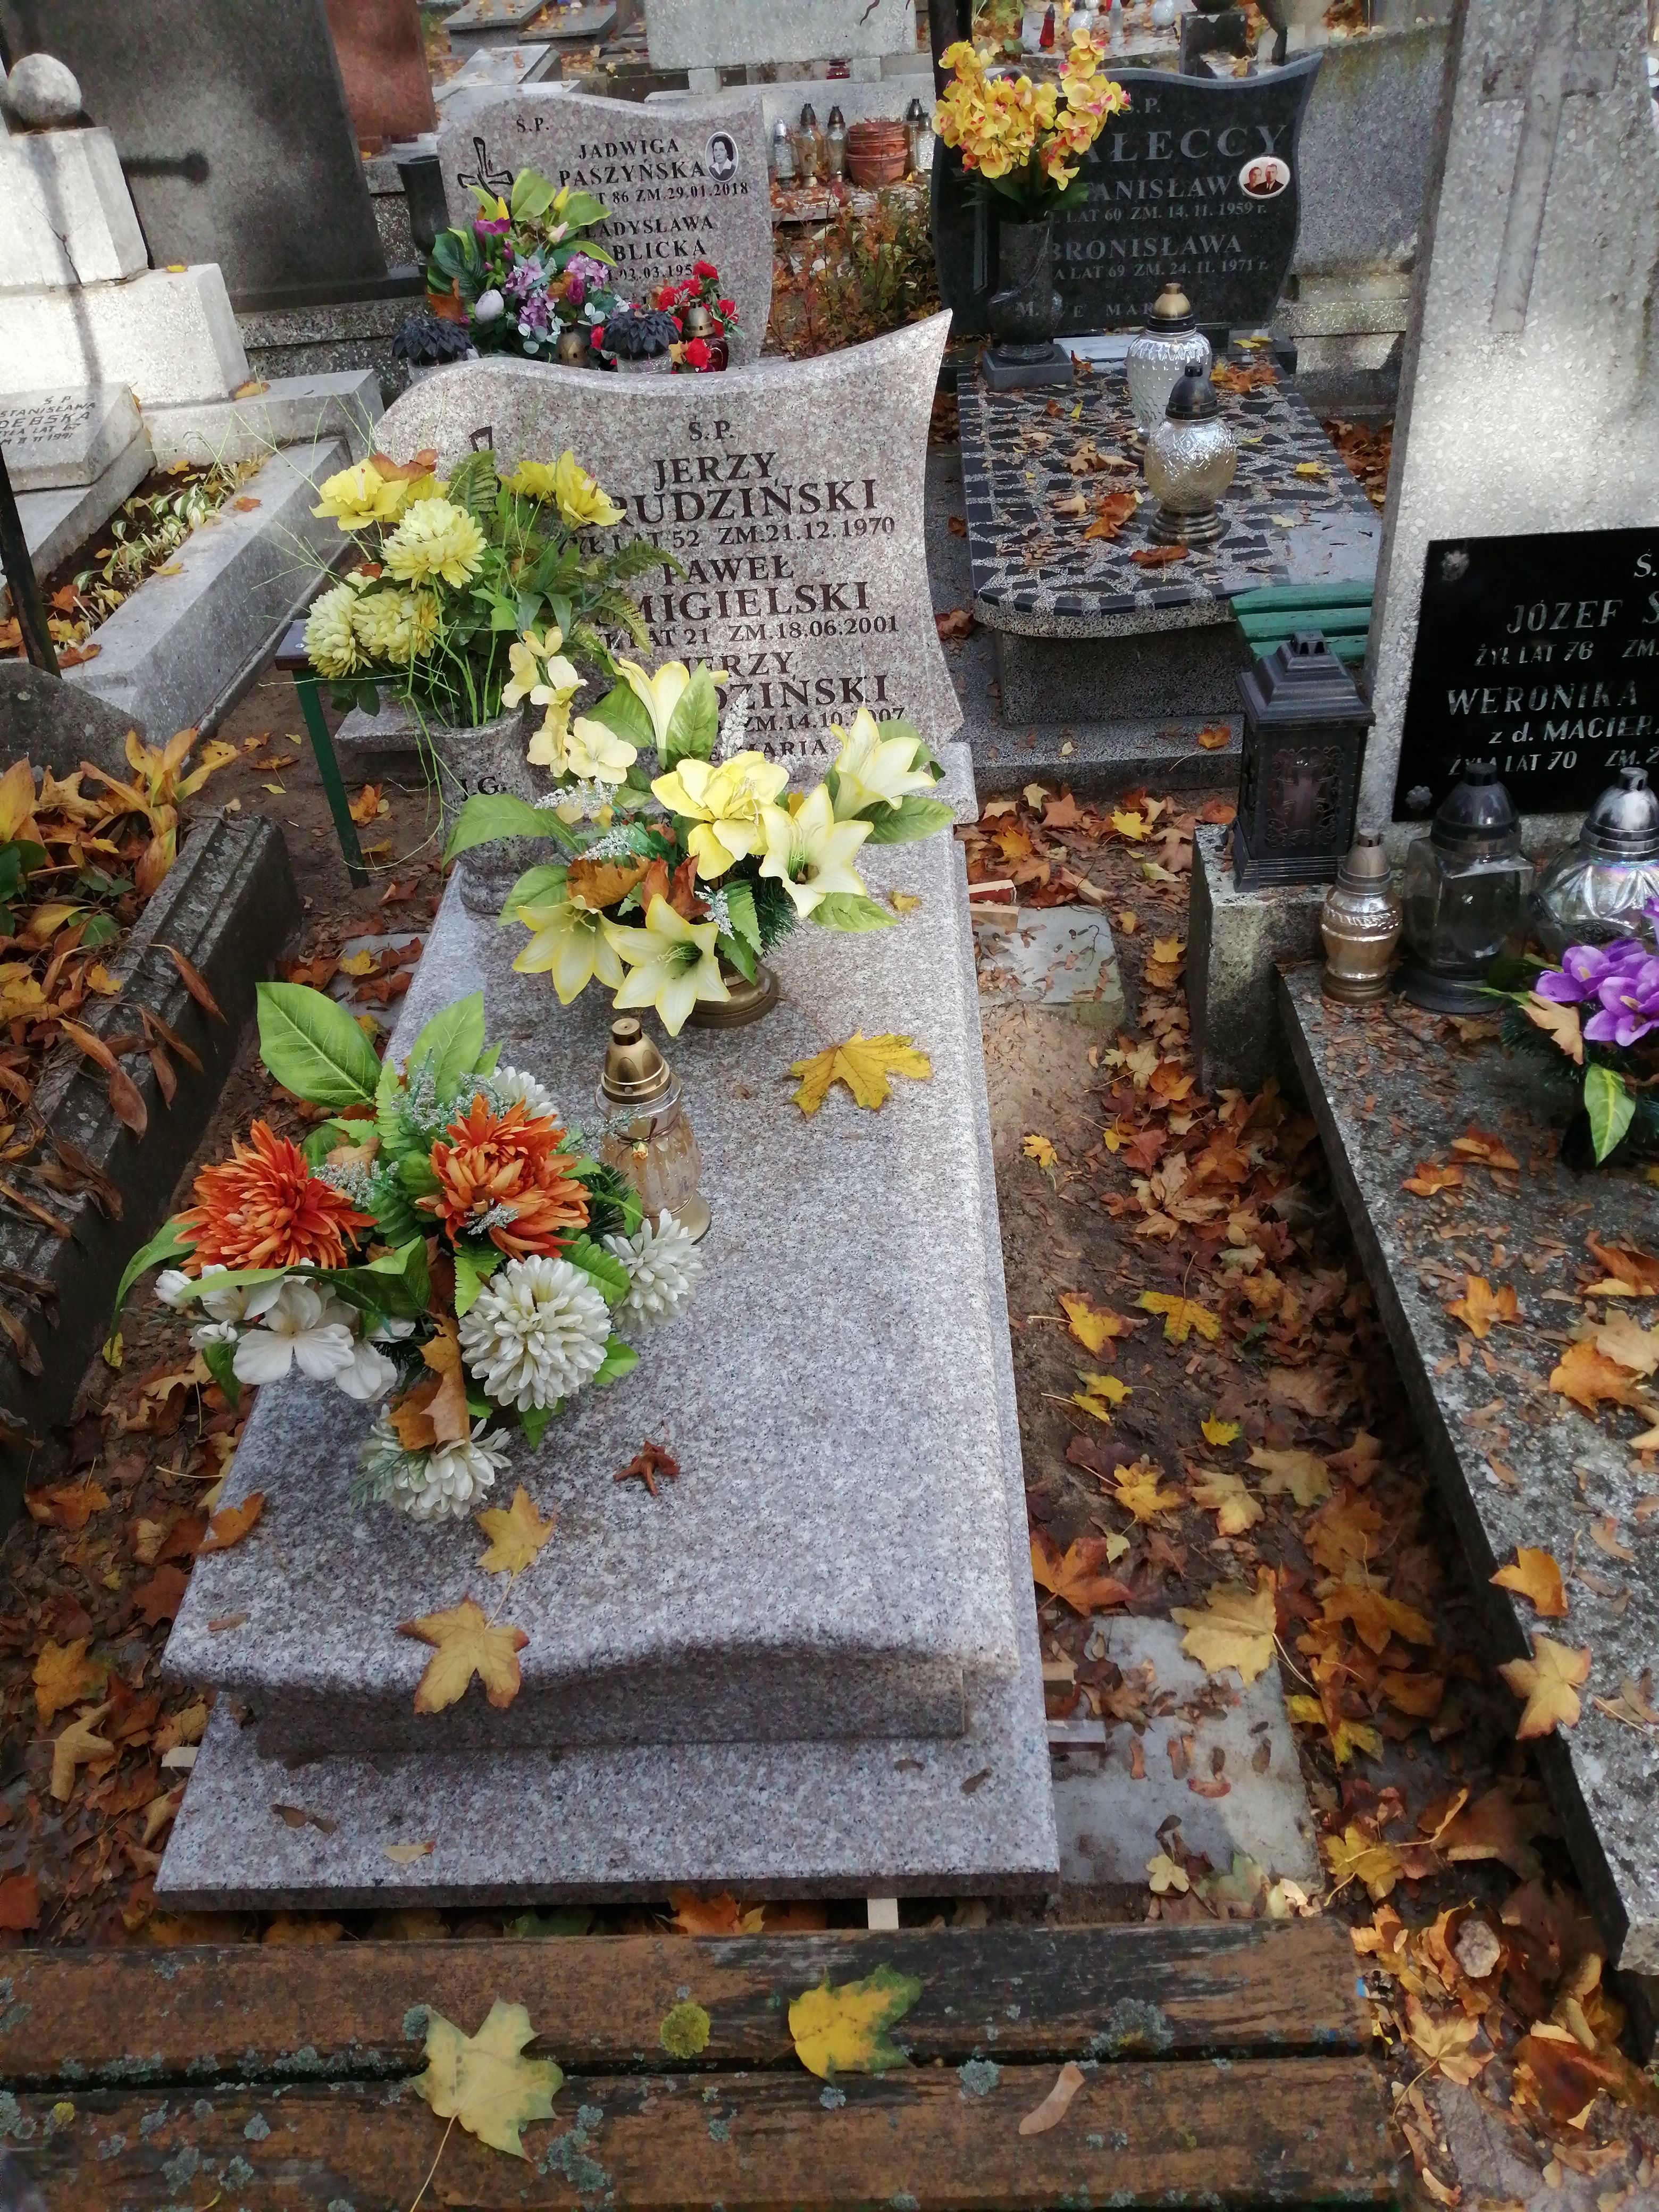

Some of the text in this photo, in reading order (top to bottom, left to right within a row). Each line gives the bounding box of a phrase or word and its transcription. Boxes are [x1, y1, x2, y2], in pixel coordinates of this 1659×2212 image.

[579, 138, 680, 160] JADWIGA
[559, 159, 706, 187] PASZYŃSKA
[613, 190, 629, 205] 86
[1067, 208, 1100, 223] LAT
[1105, 208, 1122, 221] 60
[1130, 206, 1162, 220] ZM.
[584, 215, 714, 238] ŁADYSŁAWA
[1070, 266, 1104, 279] LAT
[1109, 265, 1125, 278] 69
[1134, 261, 1164, 276] ZM.
[653, 452, 776, 491] JERZY
[673, 530, 700, 548] 52
[1506, 599, 1623, 634] JÓZEF
[684, 628, 710, 645] 21
[1519, 643, 1557, 664] LAT
[1564, 641, 1594, 661] 76
[1446, 680, 1638, 715] WERONIKA
[1544, 715, 1659, 742] MACIER
[1505, 754, 1541, 772] LAT
[1547, 750, 1578, 770] 70
